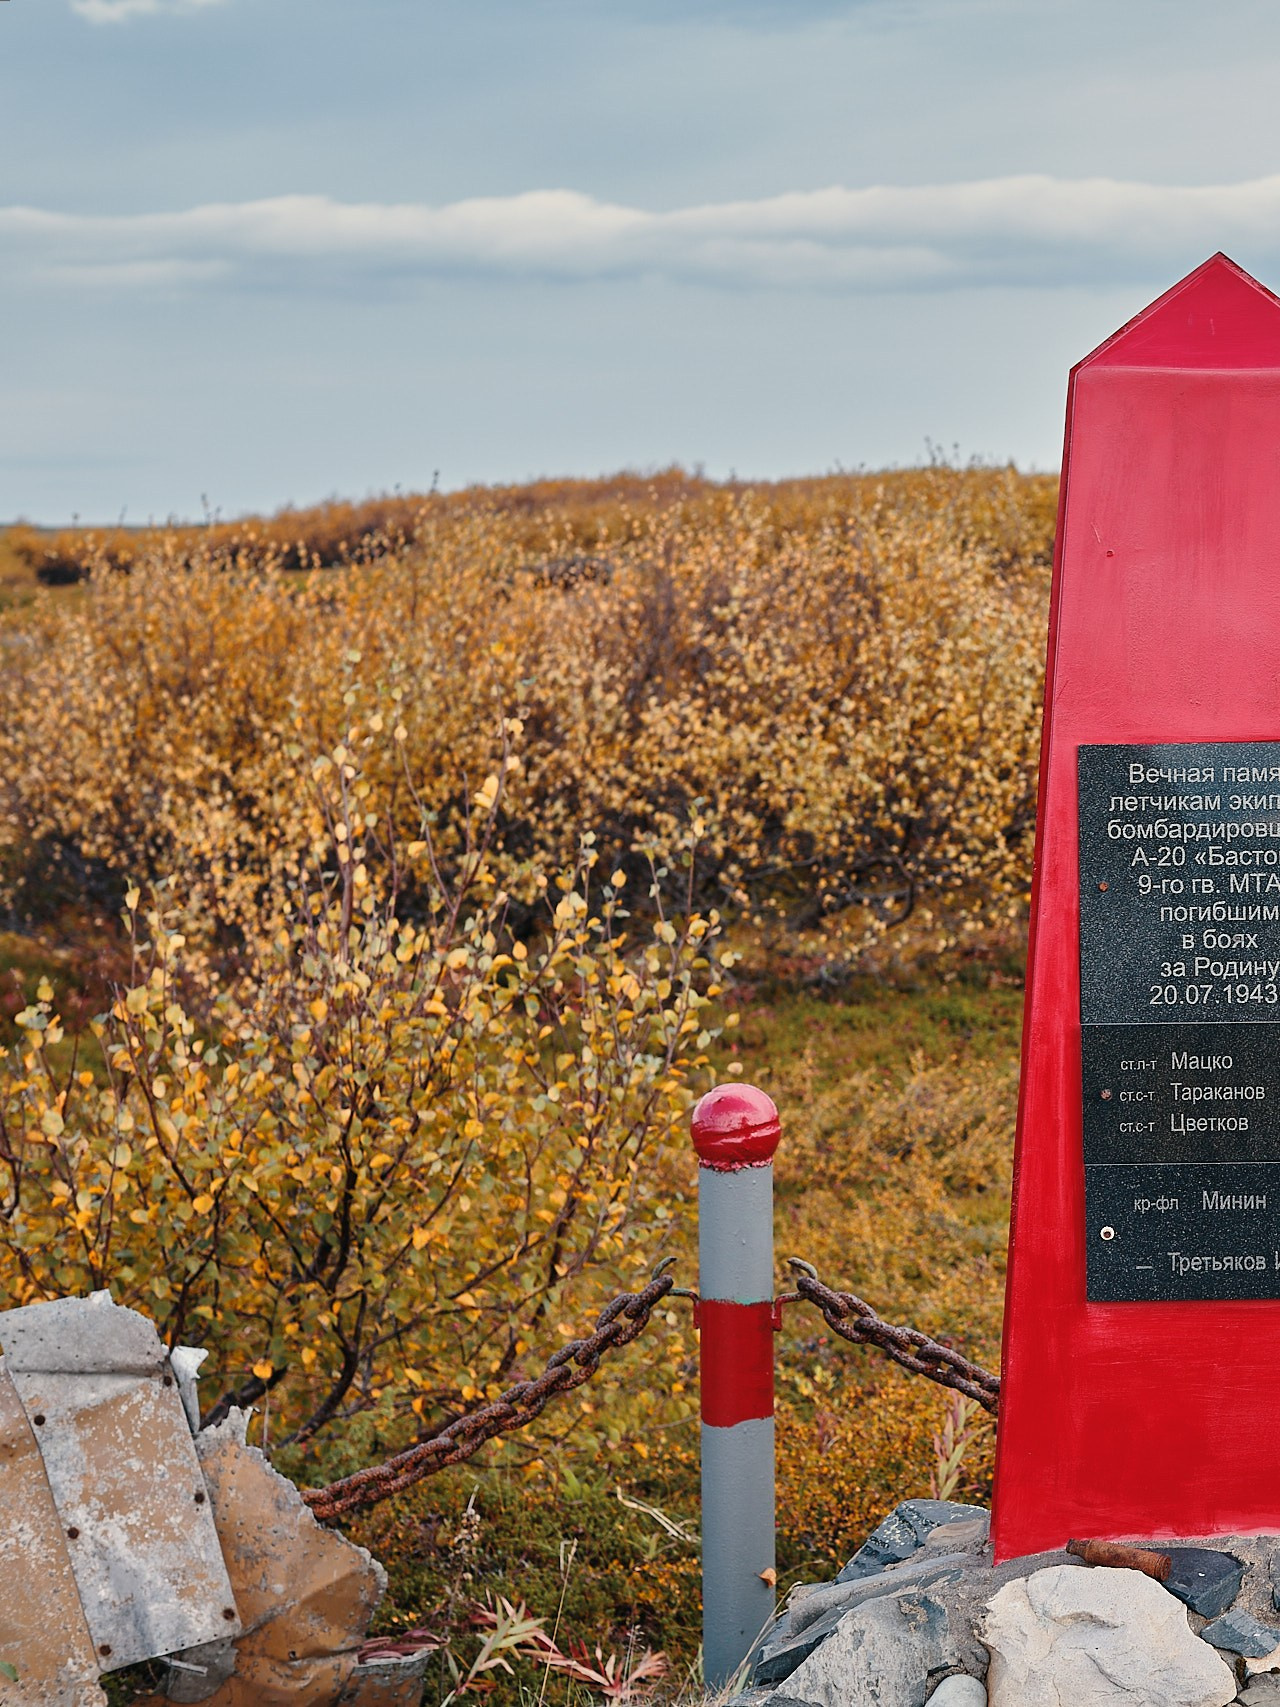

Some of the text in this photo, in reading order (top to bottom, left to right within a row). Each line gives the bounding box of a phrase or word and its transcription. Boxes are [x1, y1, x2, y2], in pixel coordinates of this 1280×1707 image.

[1129, 764, 1214, 784] Вечная
[1108, 795, 1220, 812] летчикам
[1132, 848, 1186, 867] А-20
[1138, 876, 1184, 895] 9-го
[1192, 878, 1220, 894] гв.
[1160, 901, 1279, 922] погибшим
[1182, 929, 1258, 949] в боях
[1160, 957, 1280, 980] за Родину
[1120, 1059, 1156, 1070] ст.л-т
[1171, 1052, 1232, 1072] Мацко
[1120, 1090, 1154, 1102] ст.с-т
[1170, 1082, 1265, 1104] Тараканов
[1120, 1122, 1154, 1132] ст.с-т
[1170, 1114, 1248, 1135] Цветков
[1134, 1195, 1178, 1213] кр-фл
[1202, 1190, 1266, 1210] Минин
[1168, 1252, 1266, 1276] Третьяков
